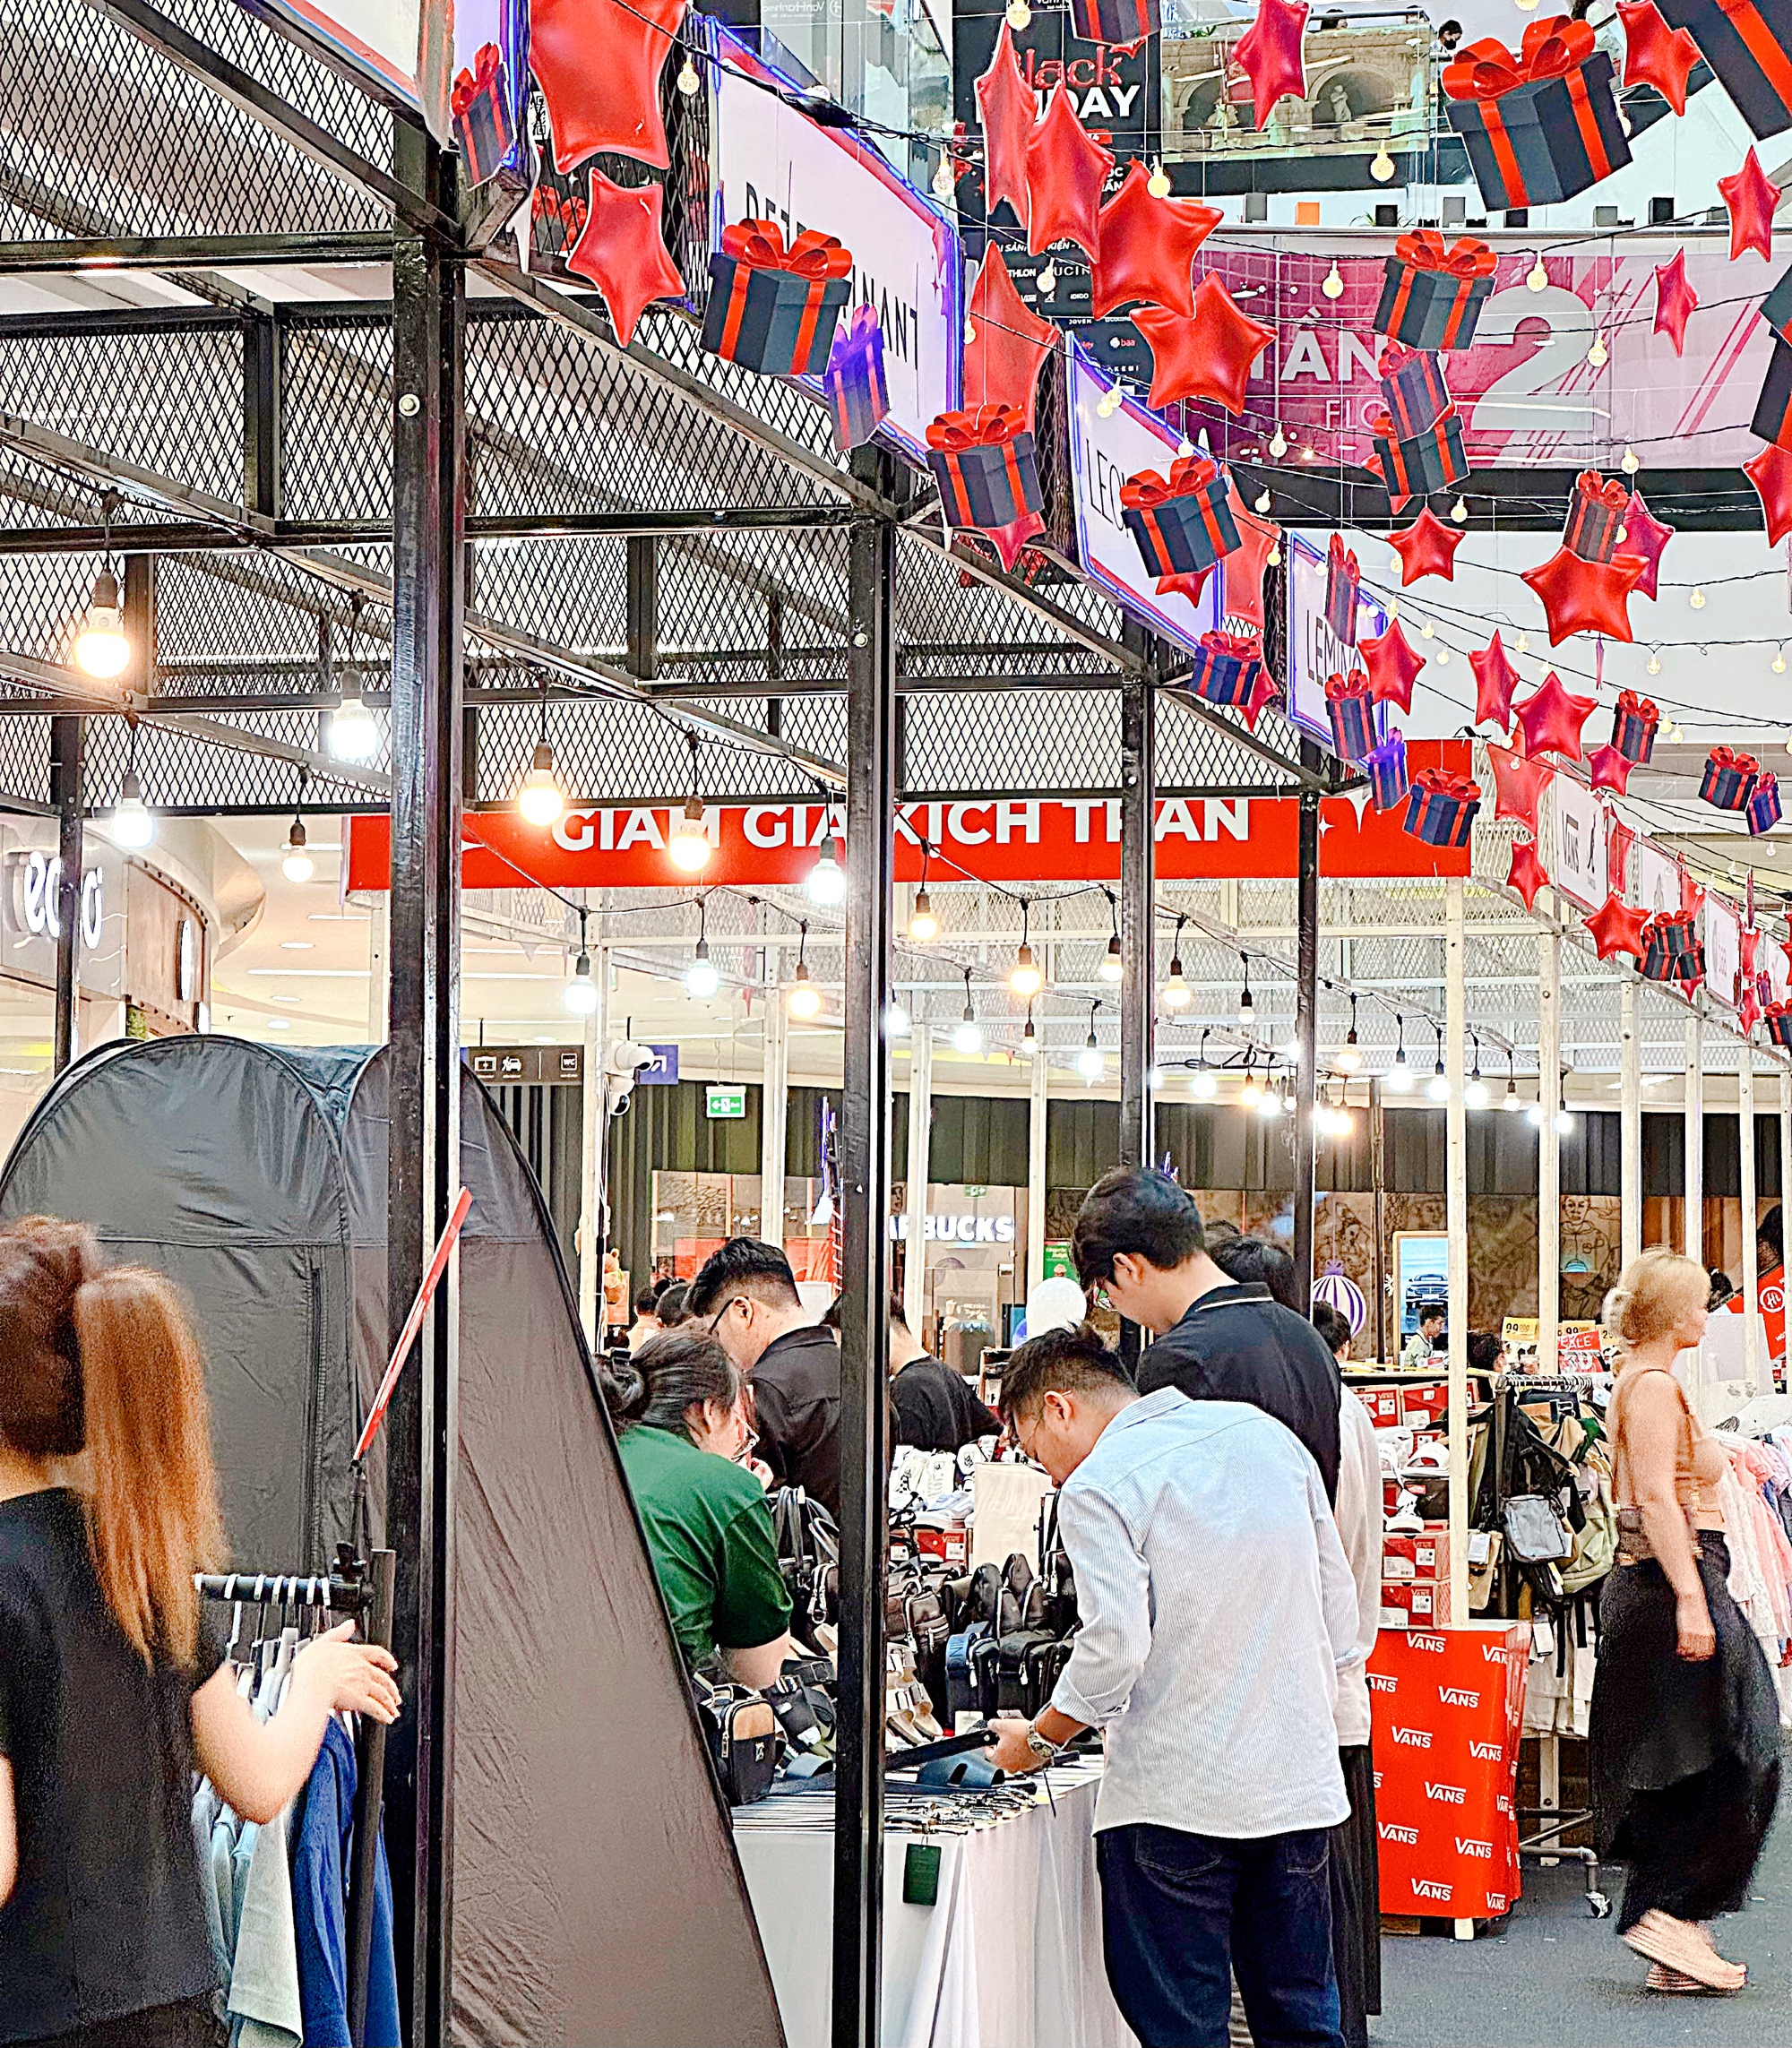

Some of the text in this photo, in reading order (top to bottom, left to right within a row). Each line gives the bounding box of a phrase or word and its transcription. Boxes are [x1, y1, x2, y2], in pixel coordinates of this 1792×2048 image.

[1013, 46, 1124, 88] lack
[1471, 284, 1594, 431] 2
[1325, 399, 1391, 430] FLO
[1086, 437, 1128, 538] LEO
[1407, 1631, 1447, 1653] VANS
[1482, 1644, 1508, 1665] VAN
[1366, 1673, 1399, 1693] ANS
[1438, 1685, 1480, 1708] VANS
[1391, 1725, 1434, 1749] VANS
[1469, 1740, 1503, 1762] VANS
[1425, 1781, 1467, 1804] VANS
[1378, 1821, 1419, 1845] VANS
[1455, 1837, 1494, 1859] VANS
[1411, 1878, 1453, 1901] VANS
[1486, 1892, 1506, 1911] VANS
